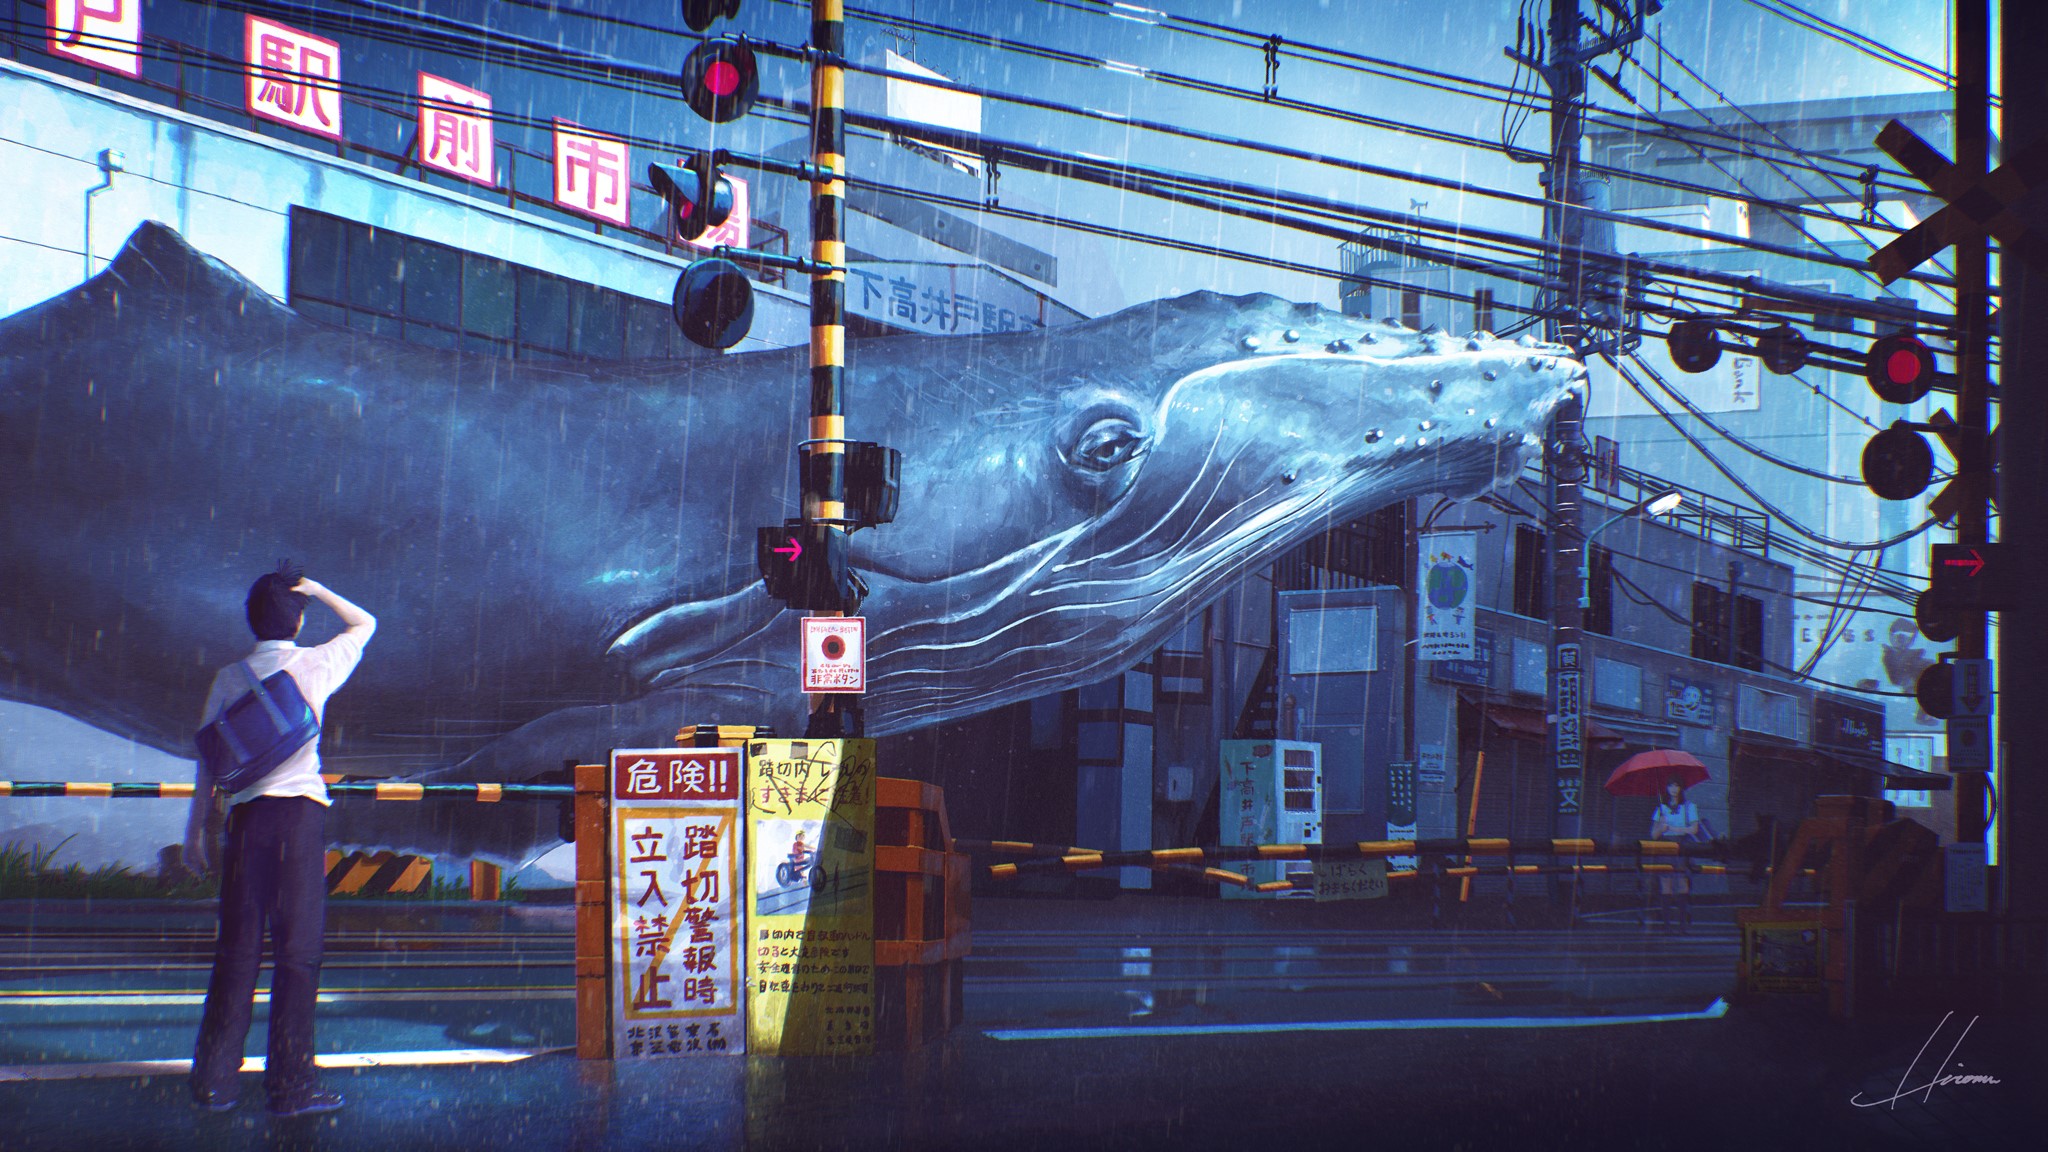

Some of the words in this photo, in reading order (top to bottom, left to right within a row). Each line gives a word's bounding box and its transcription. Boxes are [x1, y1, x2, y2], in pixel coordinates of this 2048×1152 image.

[811, 674, 858, 685] 非常ボタン
[627, 758, 728, 794] 危険!!
[1318, 878, 1384, 896] おまちください
[630, 827, 672, 1011] 立入禁止
[681, 824, 720, 1005] 踏切警報時
